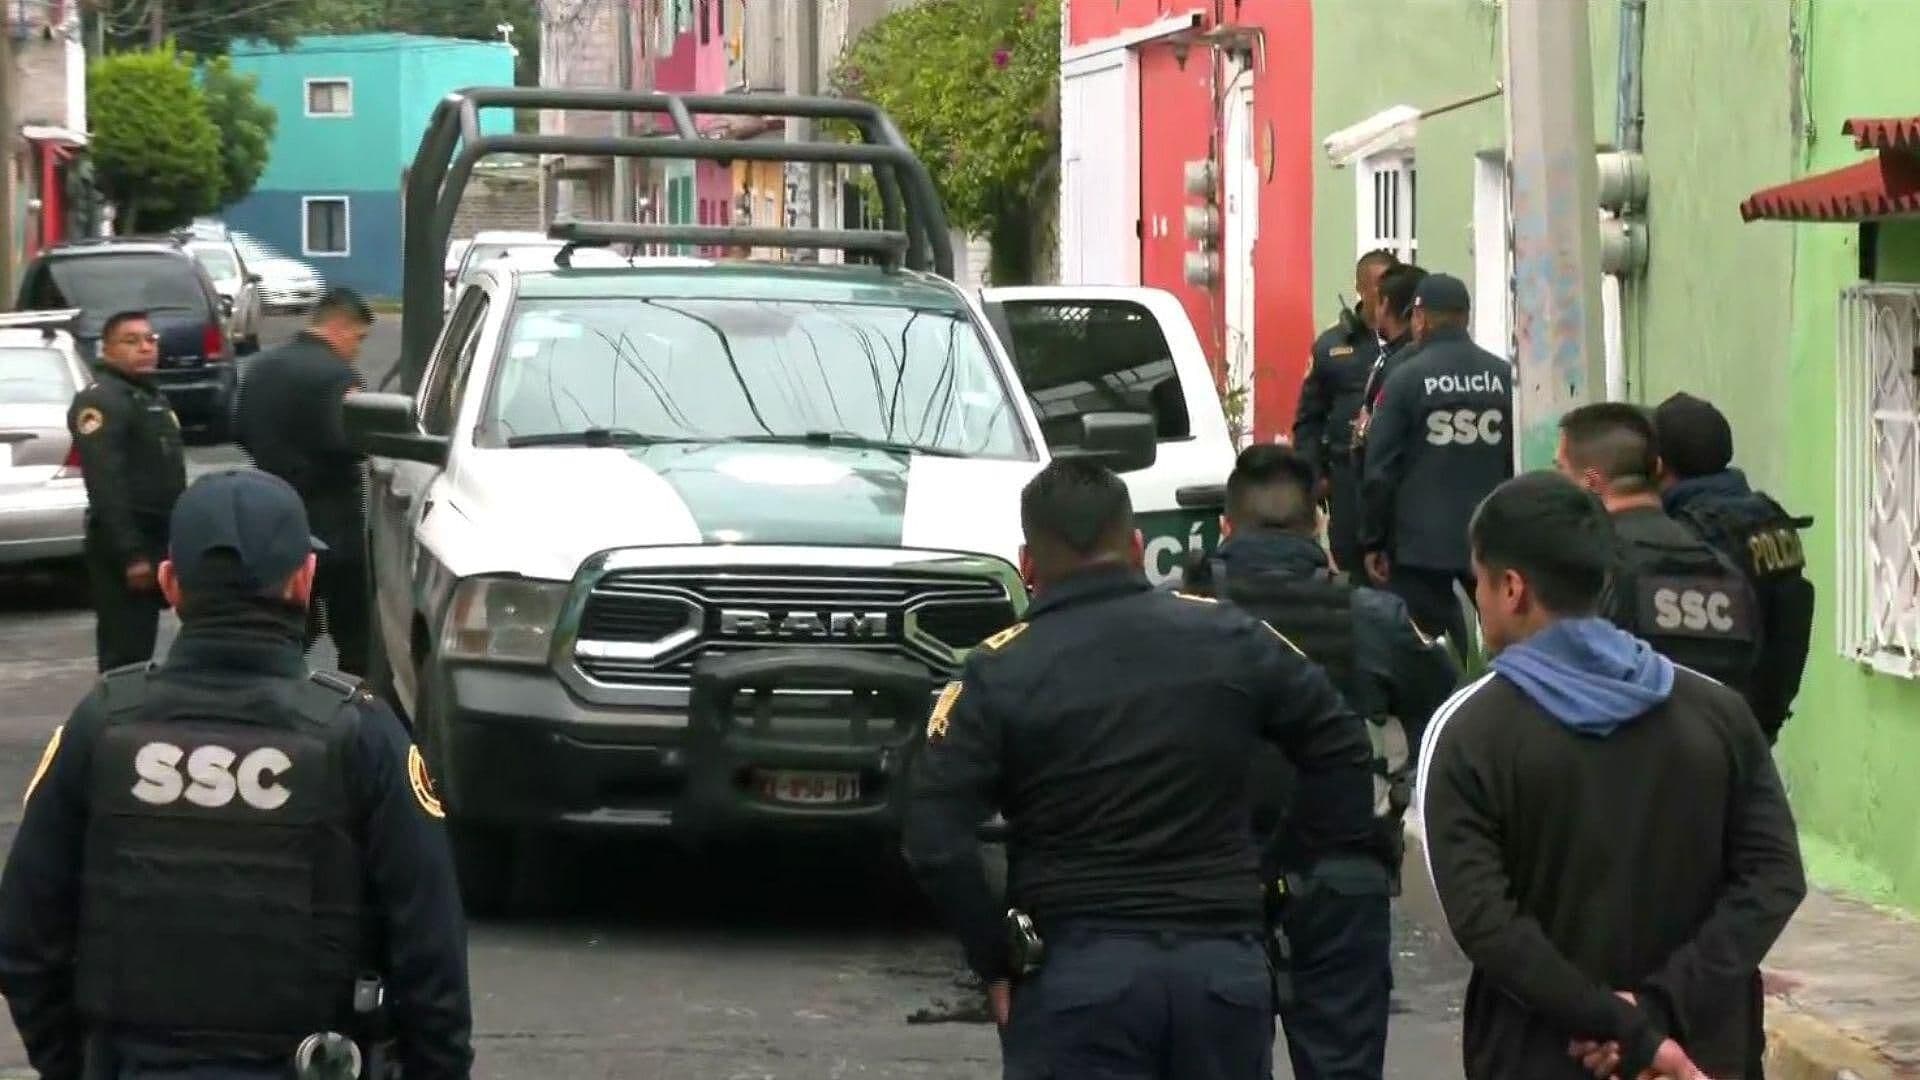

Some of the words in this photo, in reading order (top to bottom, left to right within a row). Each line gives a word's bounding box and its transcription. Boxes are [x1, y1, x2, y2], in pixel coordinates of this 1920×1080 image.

[1424, 371, 1504, 395] POLICÍA
[1426, 409, 1503, 446] SSC
[721, 609, 888, 637] RAM
[1654, 588, 1734, 632] SSC
[131, 742, 293, 810] SSC
